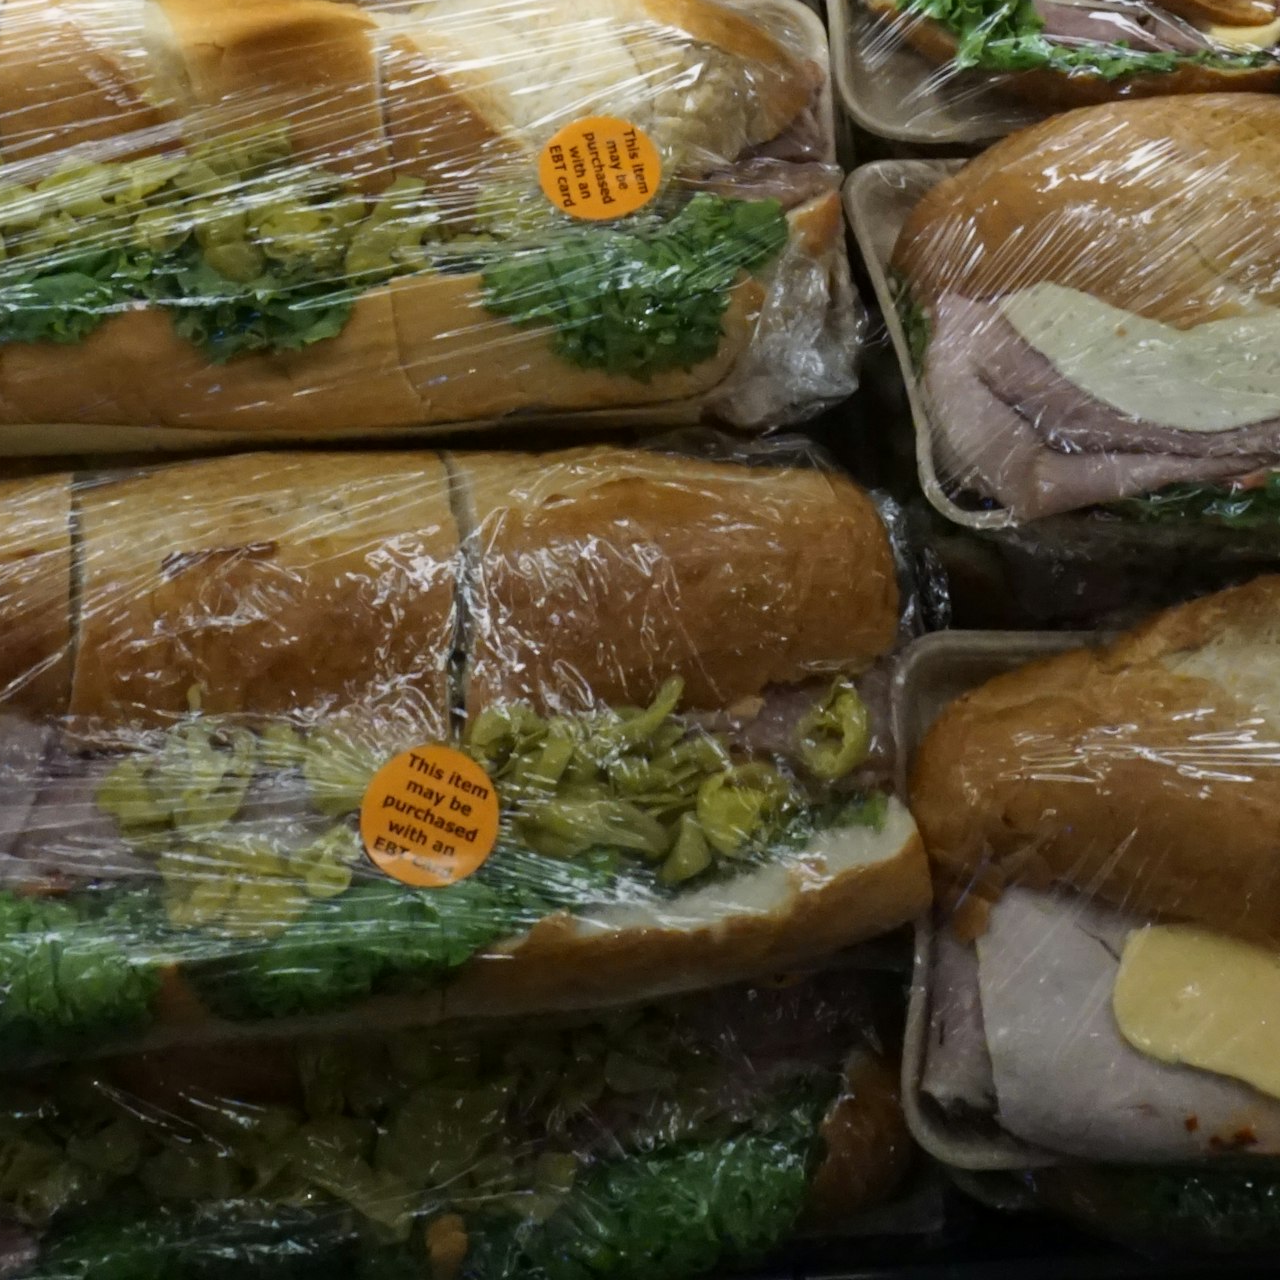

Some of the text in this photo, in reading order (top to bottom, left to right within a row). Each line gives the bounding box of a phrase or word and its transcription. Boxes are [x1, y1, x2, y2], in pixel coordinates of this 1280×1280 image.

[549, 144, 576, 208] EBT card
[569, 146, 591, 199] with an
[582, 132, 616, 204] purchased
[606, 140, 628, 190] may be
[624, 128, 648, 194] This item
[406, 780, 472, 816] may be
[409, 753, 489, 800] This item
[382, 794, 479, 842] purchased
[389, 820, 455, 855] with an
[373, 836, 410, 855] EBT
